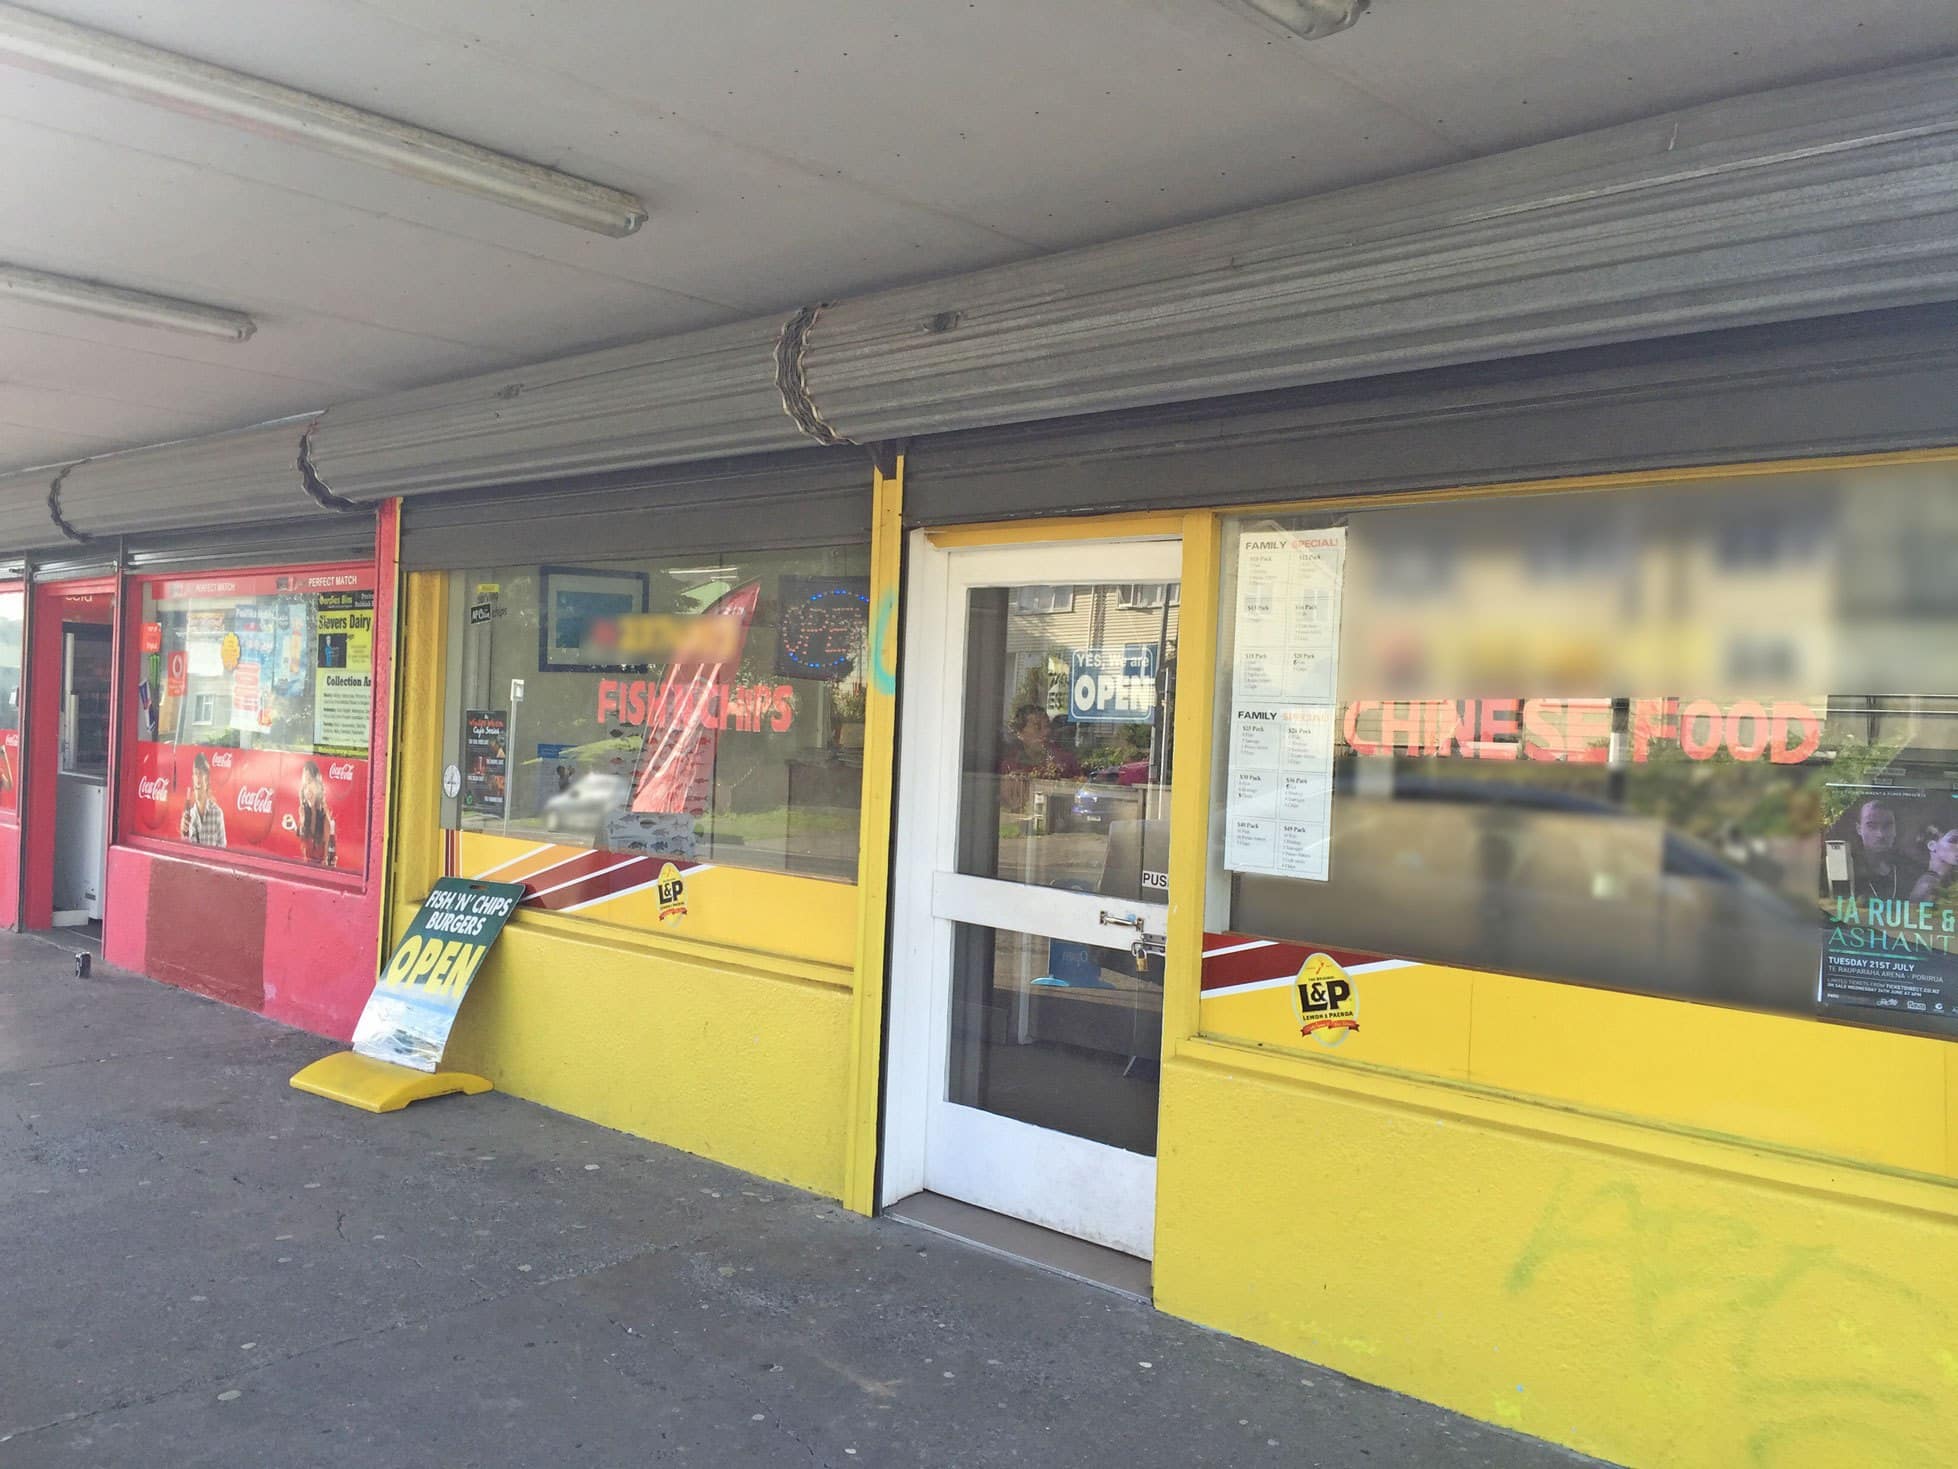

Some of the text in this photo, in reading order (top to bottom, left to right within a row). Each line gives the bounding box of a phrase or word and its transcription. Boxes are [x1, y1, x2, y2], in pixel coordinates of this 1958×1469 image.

[1245, 541, 1287, 550] FAMILY
[308, 576, 357, 587] PERFECT MATCH
[349, 614, 372, 632] Dairy
[1130, 656, 1149, 668] are
[326, 675, 372, 687] Collection Ar
[1074, 674, 1155, 712] OPEN
[597, 680, 667, 728] FISH
[700, 683, 794, 733] CHIPS
[1238, 711, 1278, 721] FAMILY
[1343, 698, 1609, 762] CHINESE
[1632, 699, 1821, 765] FOOD
[1143, 872, 1168, 887] PUS
[425, 890, 457, 910] FISH
[472, 895, 513, 917] CHIPS
[658, 880, 684, 905] L&P
[425, 911, 487, 936] BURGERS
[1829, 895, 1956, 932] JA RULE &
[1828, 926, 1956, 956] ASHANT
[385, 934, 487, 999] OPEN
[1828, 956, 1915, 972] TUESDAY 21ST JULY
[1297, 980, 1351, 1013] L&P
